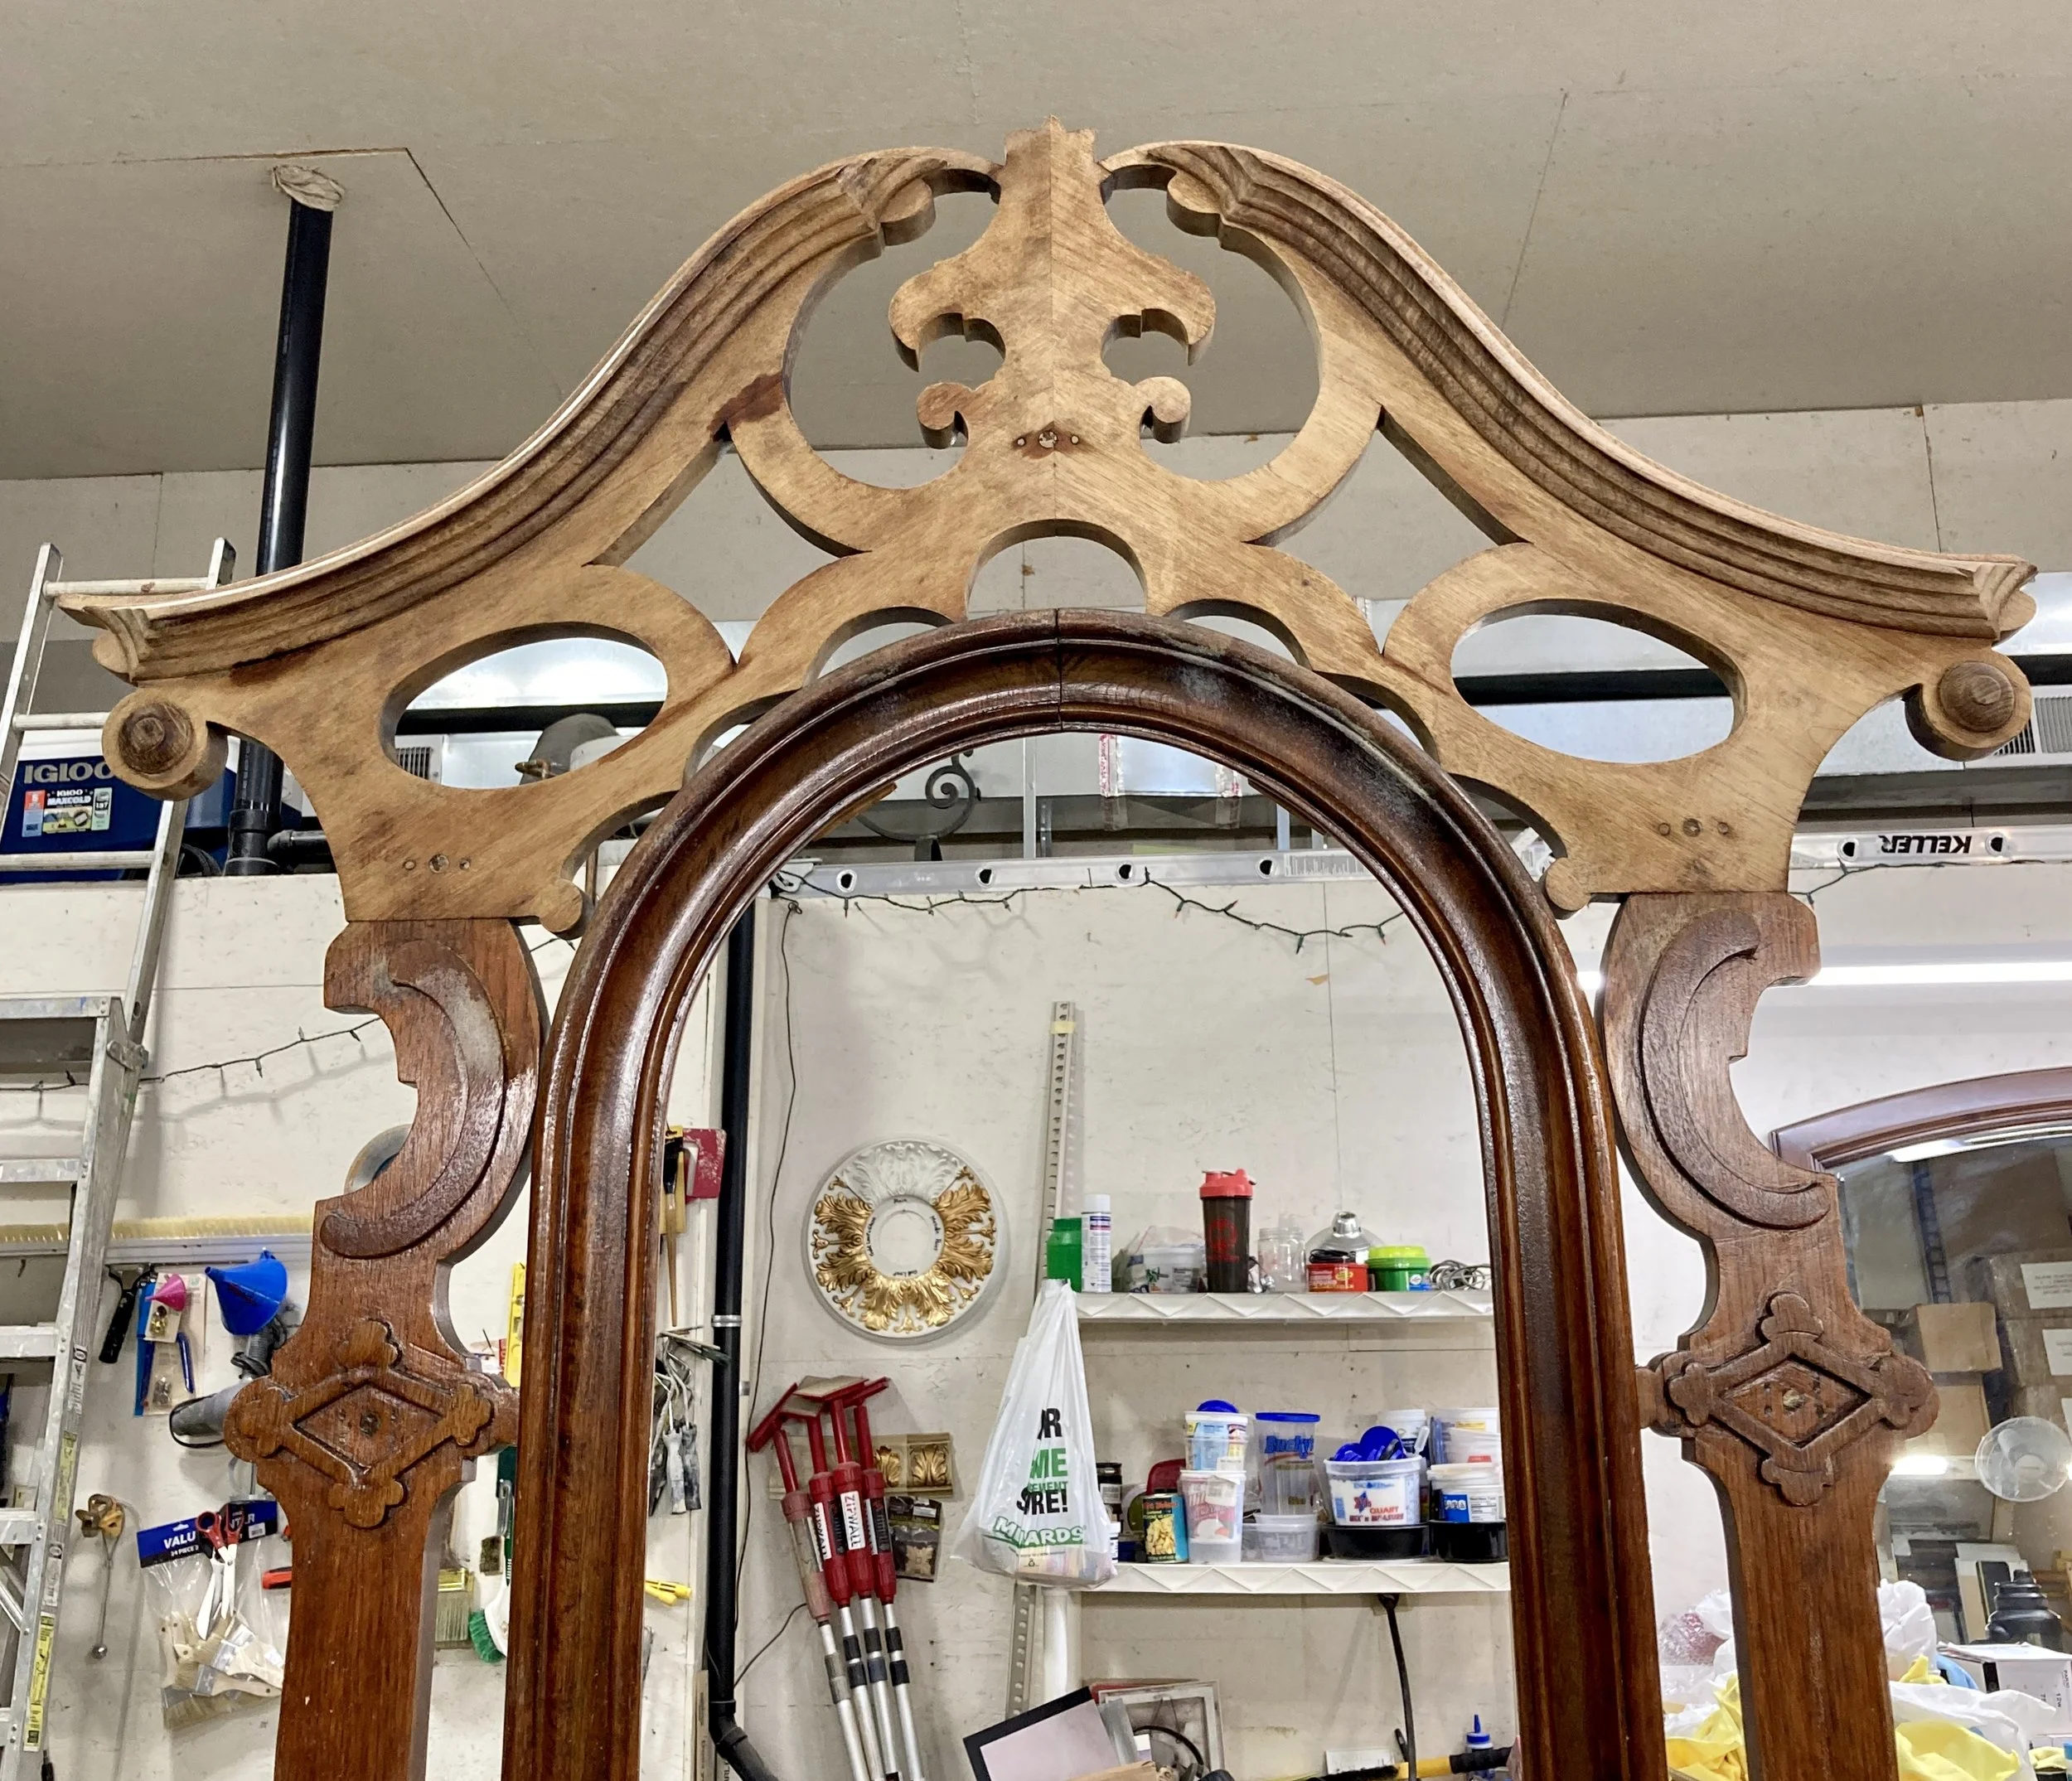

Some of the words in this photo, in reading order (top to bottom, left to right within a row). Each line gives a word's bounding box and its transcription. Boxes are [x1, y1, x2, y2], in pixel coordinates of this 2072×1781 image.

[24, 762, 114, 784] IGLOO
[1879, 835, 1973, 854] KELLER
[1370, 1506, 1399, 1515] QUART
[179, 1546, 195, 1556] PIECE
